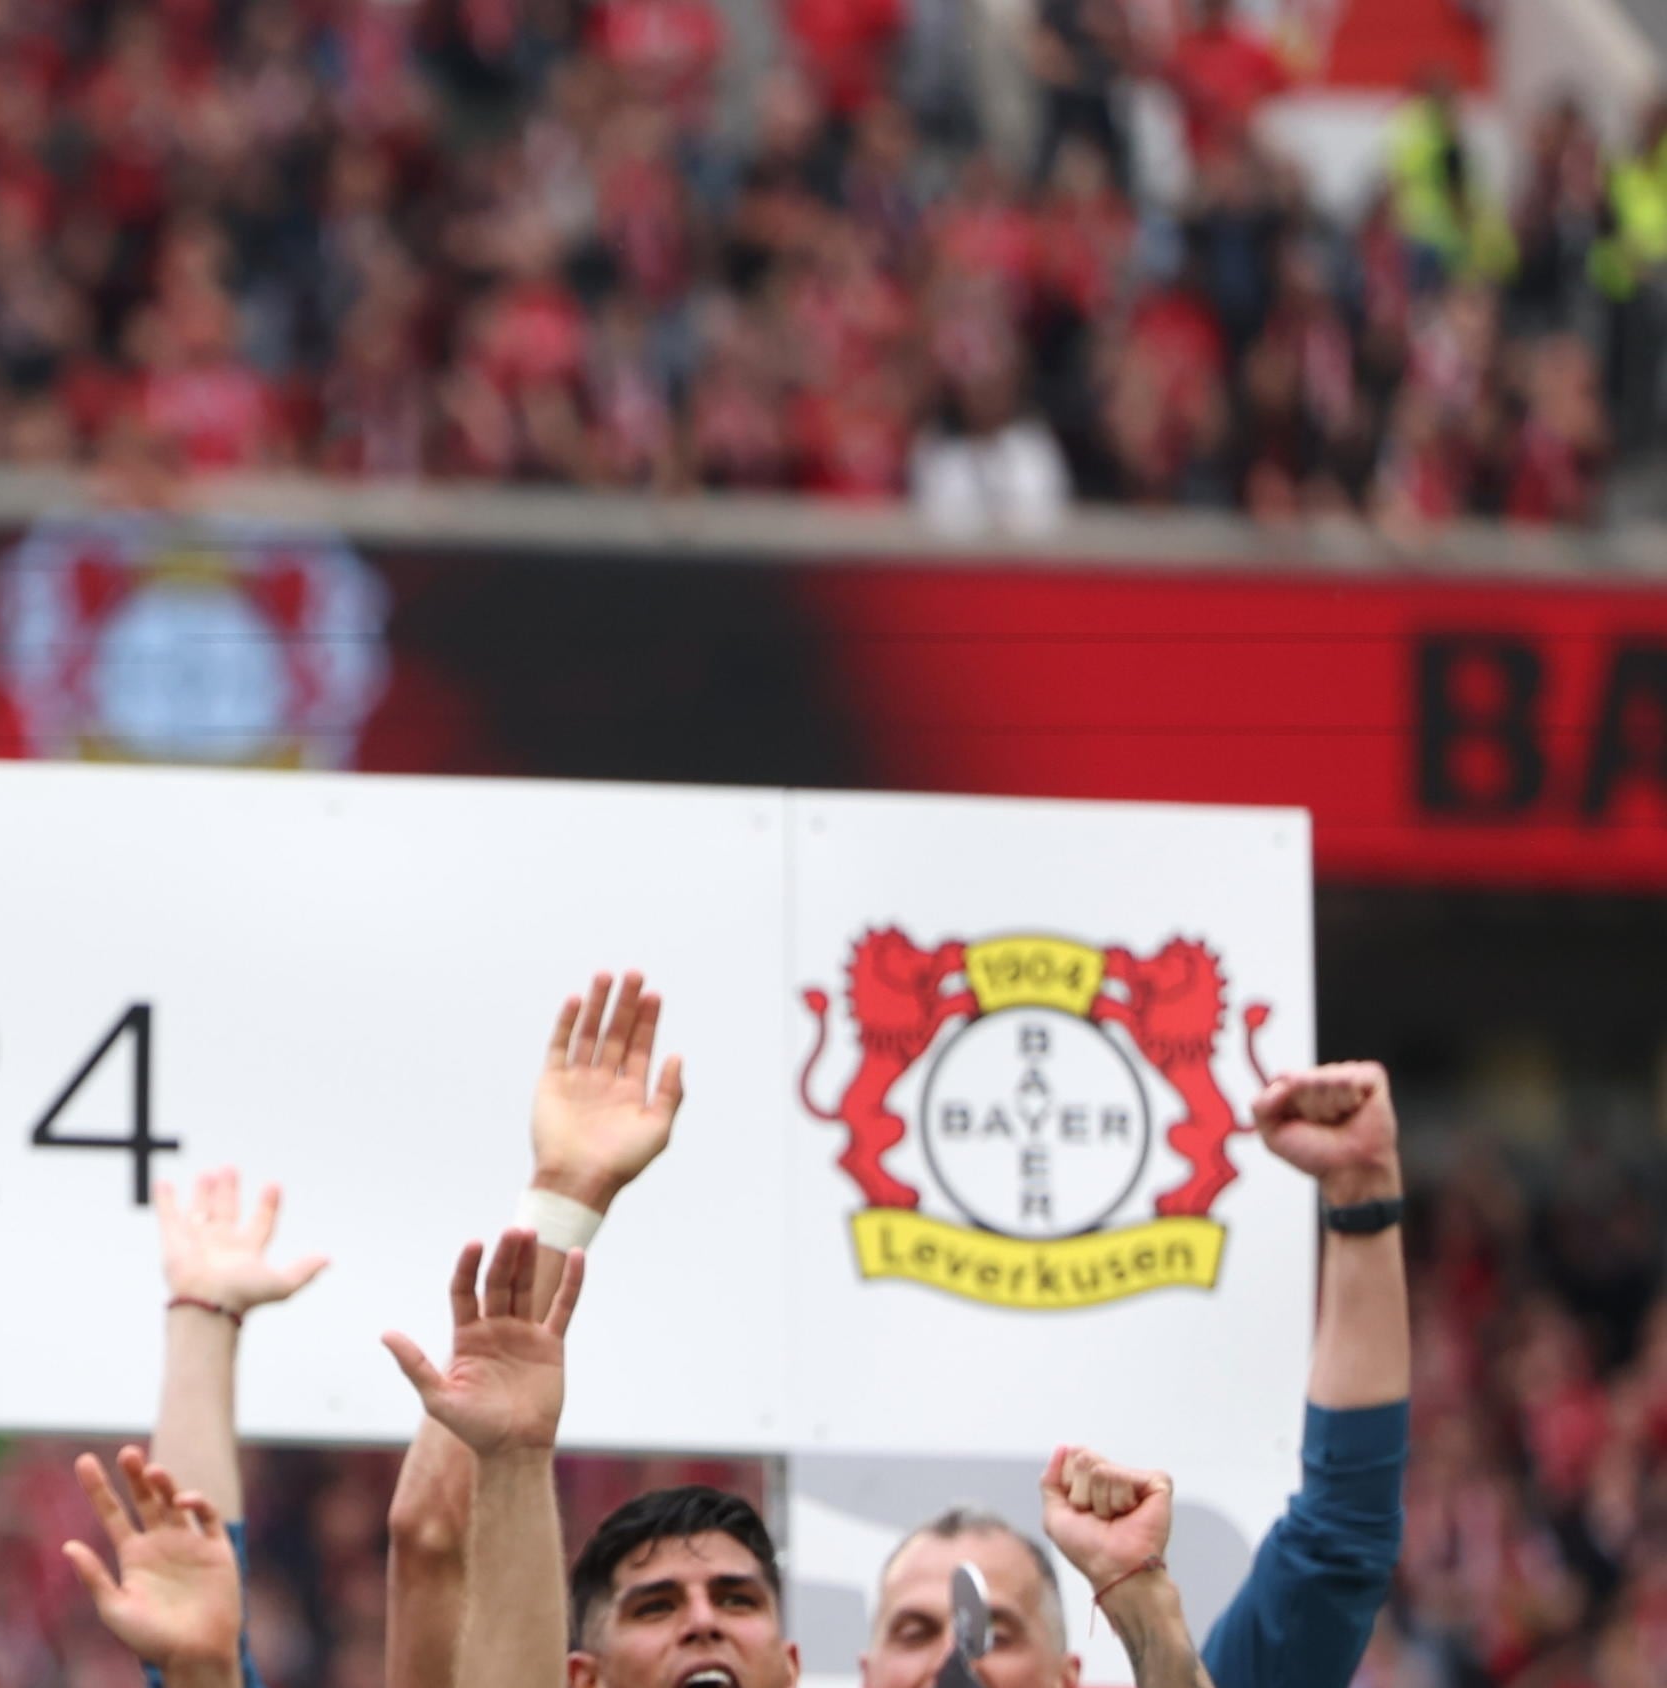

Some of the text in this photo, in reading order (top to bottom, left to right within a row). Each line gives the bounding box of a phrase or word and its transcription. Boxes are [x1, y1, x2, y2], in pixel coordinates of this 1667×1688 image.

[982, 951, 1086, 992] 1904
[940, 1103, 1131, 1141] BAYER
[1019, 1023, 1052, 1222] BAYER
[878, 1224, 1195, 1298] Leverkusen
